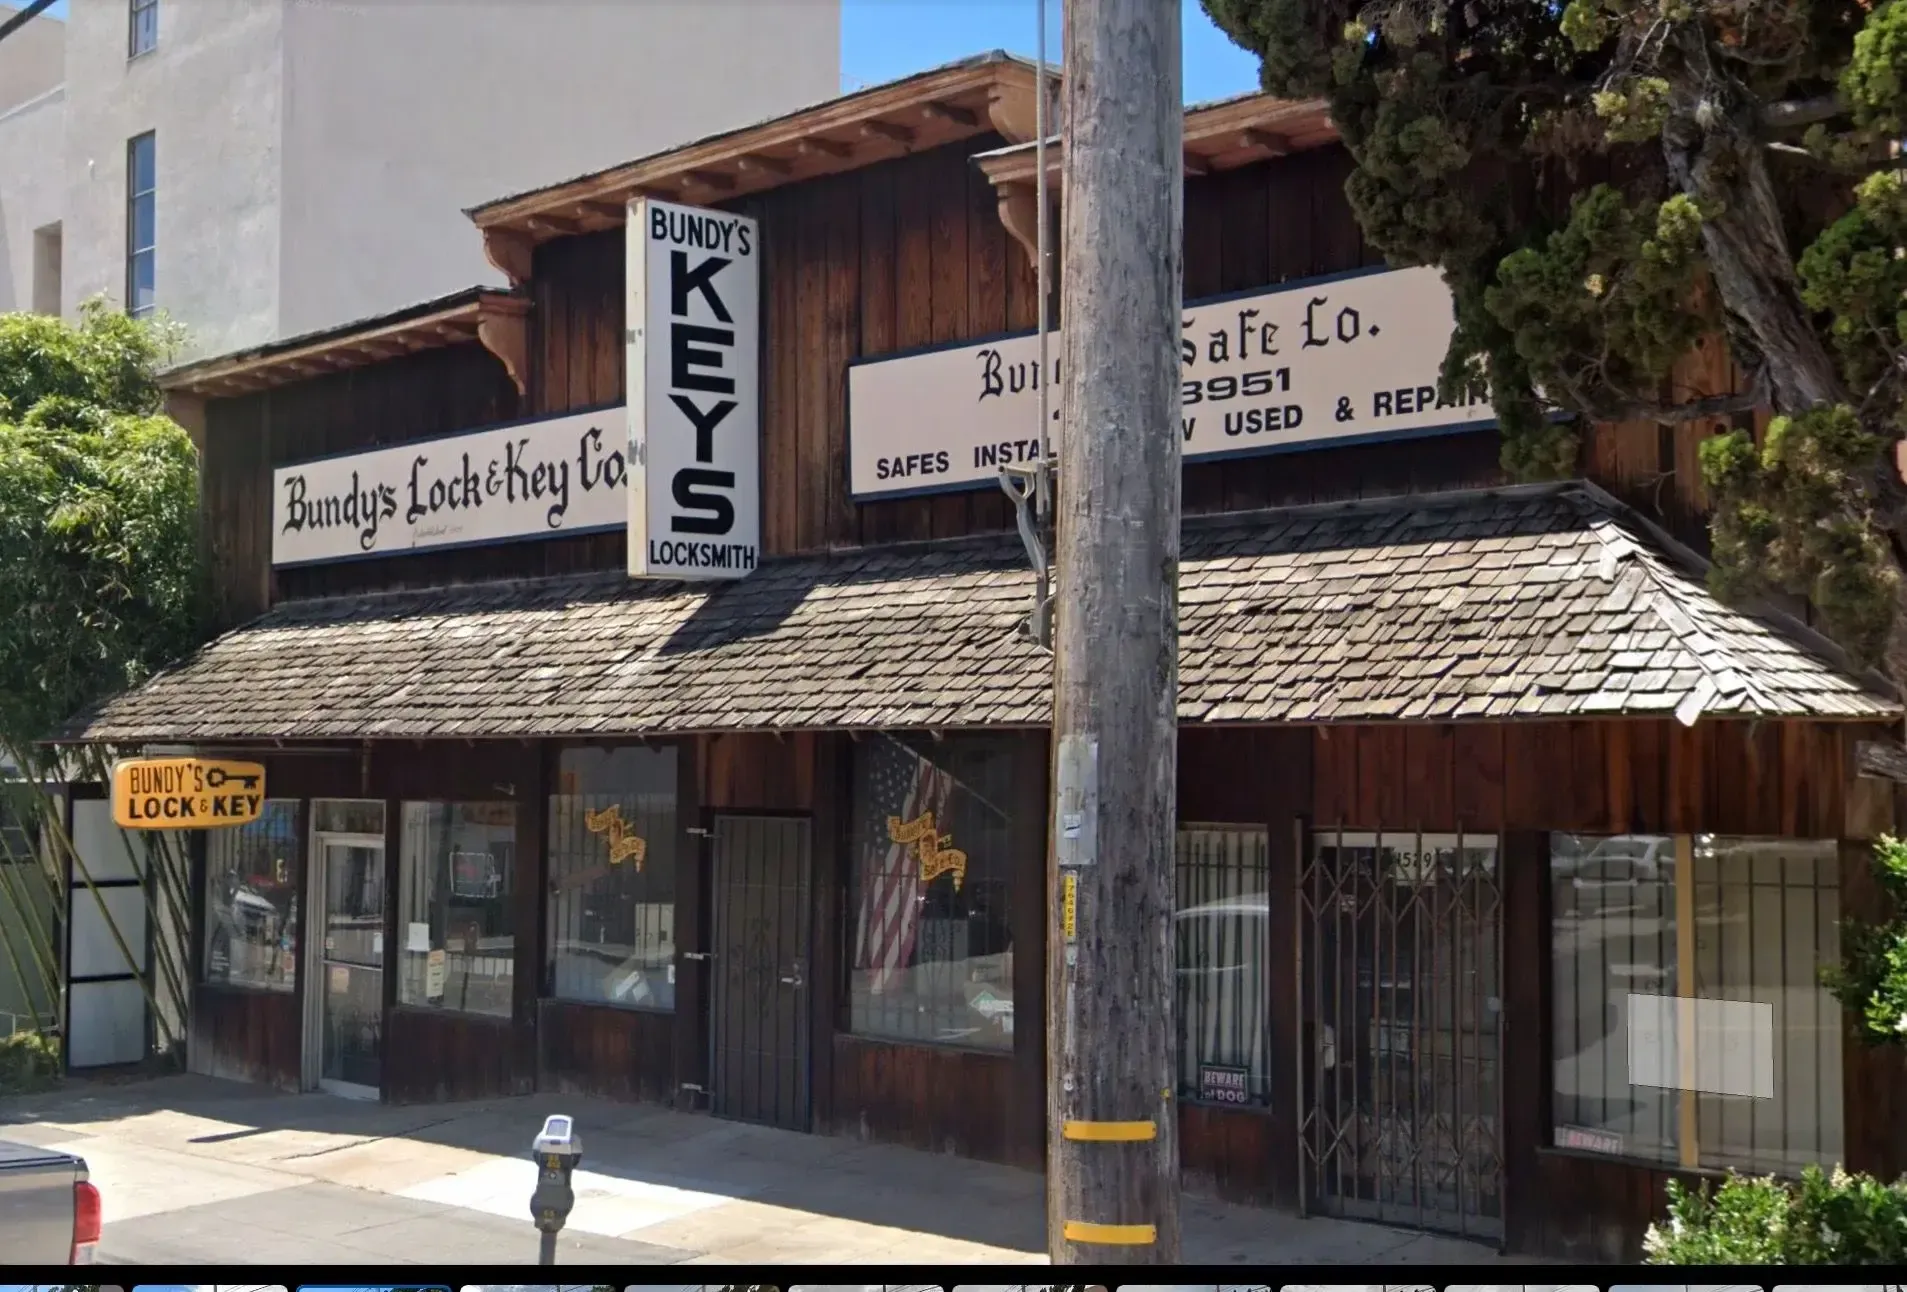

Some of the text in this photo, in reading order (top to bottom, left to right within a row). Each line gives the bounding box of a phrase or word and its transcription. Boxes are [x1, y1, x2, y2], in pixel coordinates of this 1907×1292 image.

[651, 207, 751, 256] BUNDY'S
[667, 250, 739, 536] KEYS
[1225, 404, 1303, 436] USED
[1335, 396, 1355, 422] &
[877, 451, 949, 480] SAFES
[282, 471, 397, 550] Bundy's
[406, 453, 482, 525] Lock
[504, 439, 569, 529] Key
[650, 540, 755, 569] LOCKSMITH
[130, 763, 203, 794] BUNDY'S
[129, 794, 261, 820] LOCK & KEY
[1203, 1071, 1245, 1087] BEWARE
[1217, 1089, 1245, 1103] DOG
